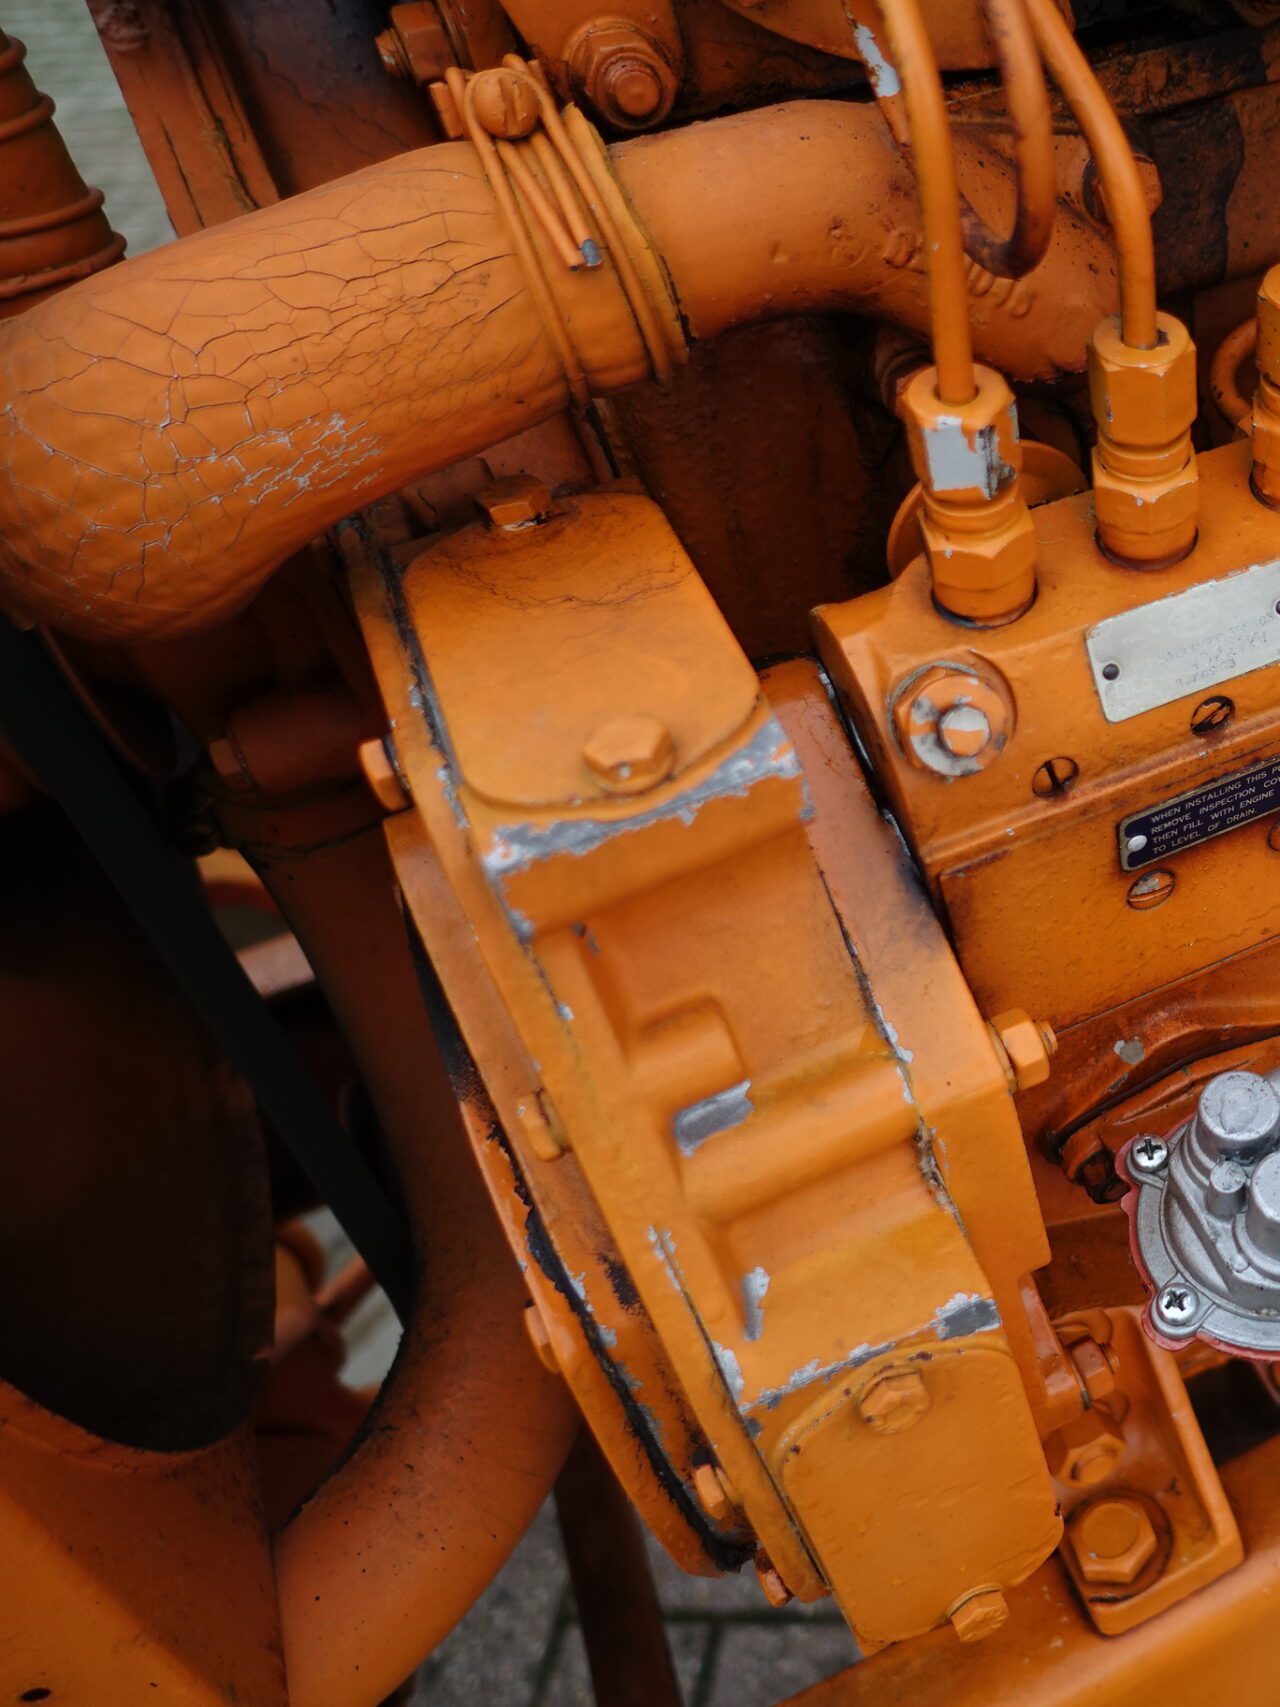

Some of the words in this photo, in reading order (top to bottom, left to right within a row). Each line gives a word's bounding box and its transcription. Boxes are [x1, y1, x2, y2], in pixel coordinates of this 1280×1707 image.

[1151, 806, 1181, 823] WHEN
[1185, 781, 1242, 810] INSTALLING
[1245, 771, 1268, 784] THIS
[1151, 813, 1191, 834] REMOVE
[1199, 786, 1256, 815] INSPECTION
[1153, 830, 1178, 844] THEN
[1183, 819, 1203, 832] FILL
[1210, 807, 1235, 820] WITH
[1240, 790, 1274, 809] ENGINE
[1153, 845, 1167, 855] TO
[1172, 832, 1202, 847] LEVEL
[1208, 823, 1221, 832] OF
